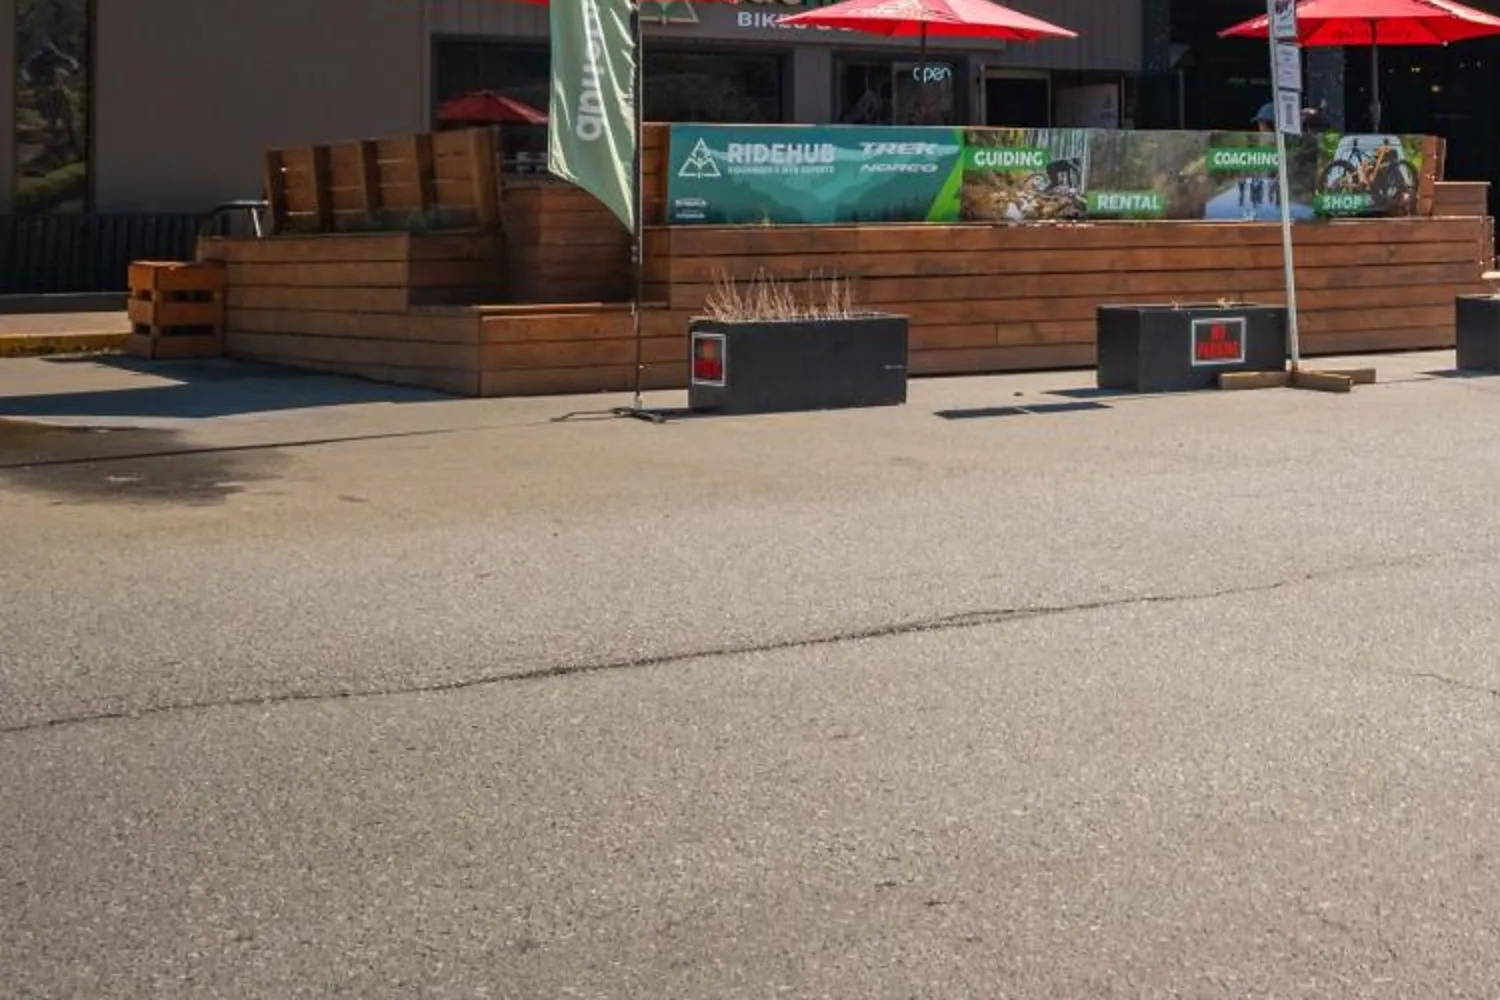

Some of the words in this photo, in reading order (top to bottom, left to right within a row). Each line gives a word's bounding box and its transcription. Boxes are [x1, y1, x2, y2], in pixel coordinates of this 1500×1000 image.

[727, 143, 835, 164] RIDEHUB
[859, 142, 938, 155] TREK
[973, 151, 1043, 167] GUIDING
[1097, 193, 1161, 210] RENTAL
[1323, 195, 1363, 209] SHOP
